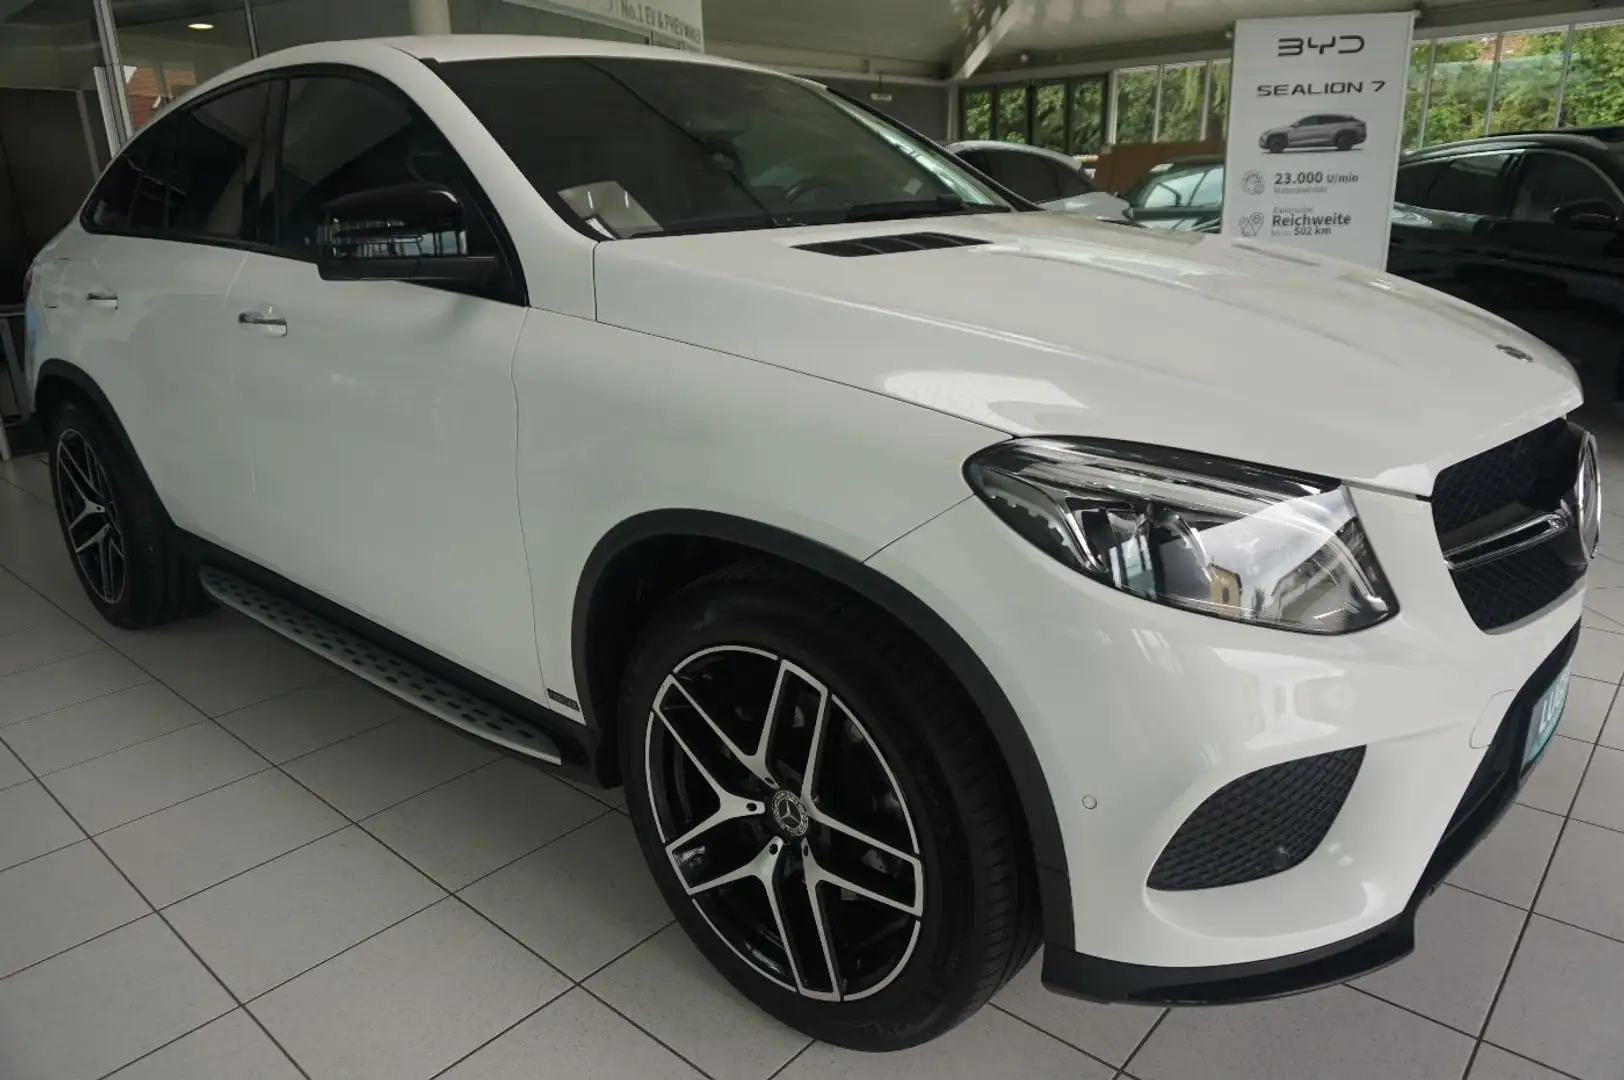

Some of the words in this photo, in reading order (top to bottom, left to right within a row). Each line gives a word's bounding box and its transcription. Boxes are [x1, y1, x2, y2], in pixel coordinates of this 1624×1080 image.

[1278, 35, 1365, 57] BYD
[1257, 81, 1363, 97] SEALION
[1371, 80, 1386, 92] 7
[1274, 172, 1323, 185] 23.000
[1327, 172, 1359, 184] U/min
[1272, 213, 1351, 227] Reichweite
[1294, 227, 1312, 236] 502
[1315, 226, 1331, 236] km
